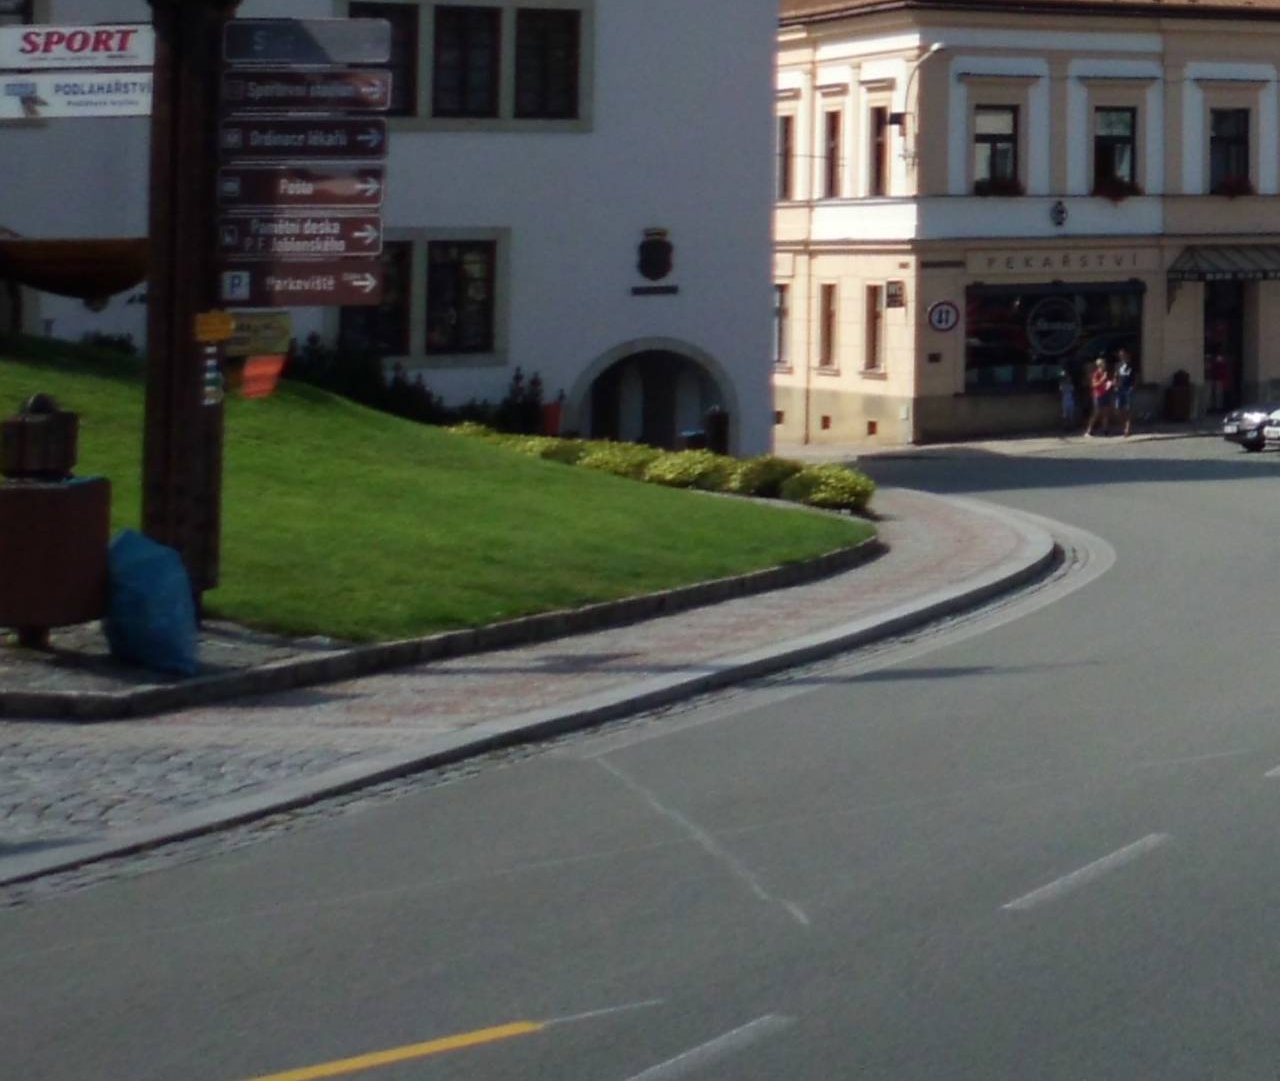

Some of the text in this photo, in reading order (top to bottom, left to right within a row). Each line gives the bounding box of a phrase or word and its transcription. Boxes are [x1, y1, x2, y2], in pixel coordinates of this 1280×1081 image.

[19, 29, 138, 54] SPORT
[304, 219, 340, 235] deska
[987, 253, 1137, 269] PEKAŘSTVÍ
